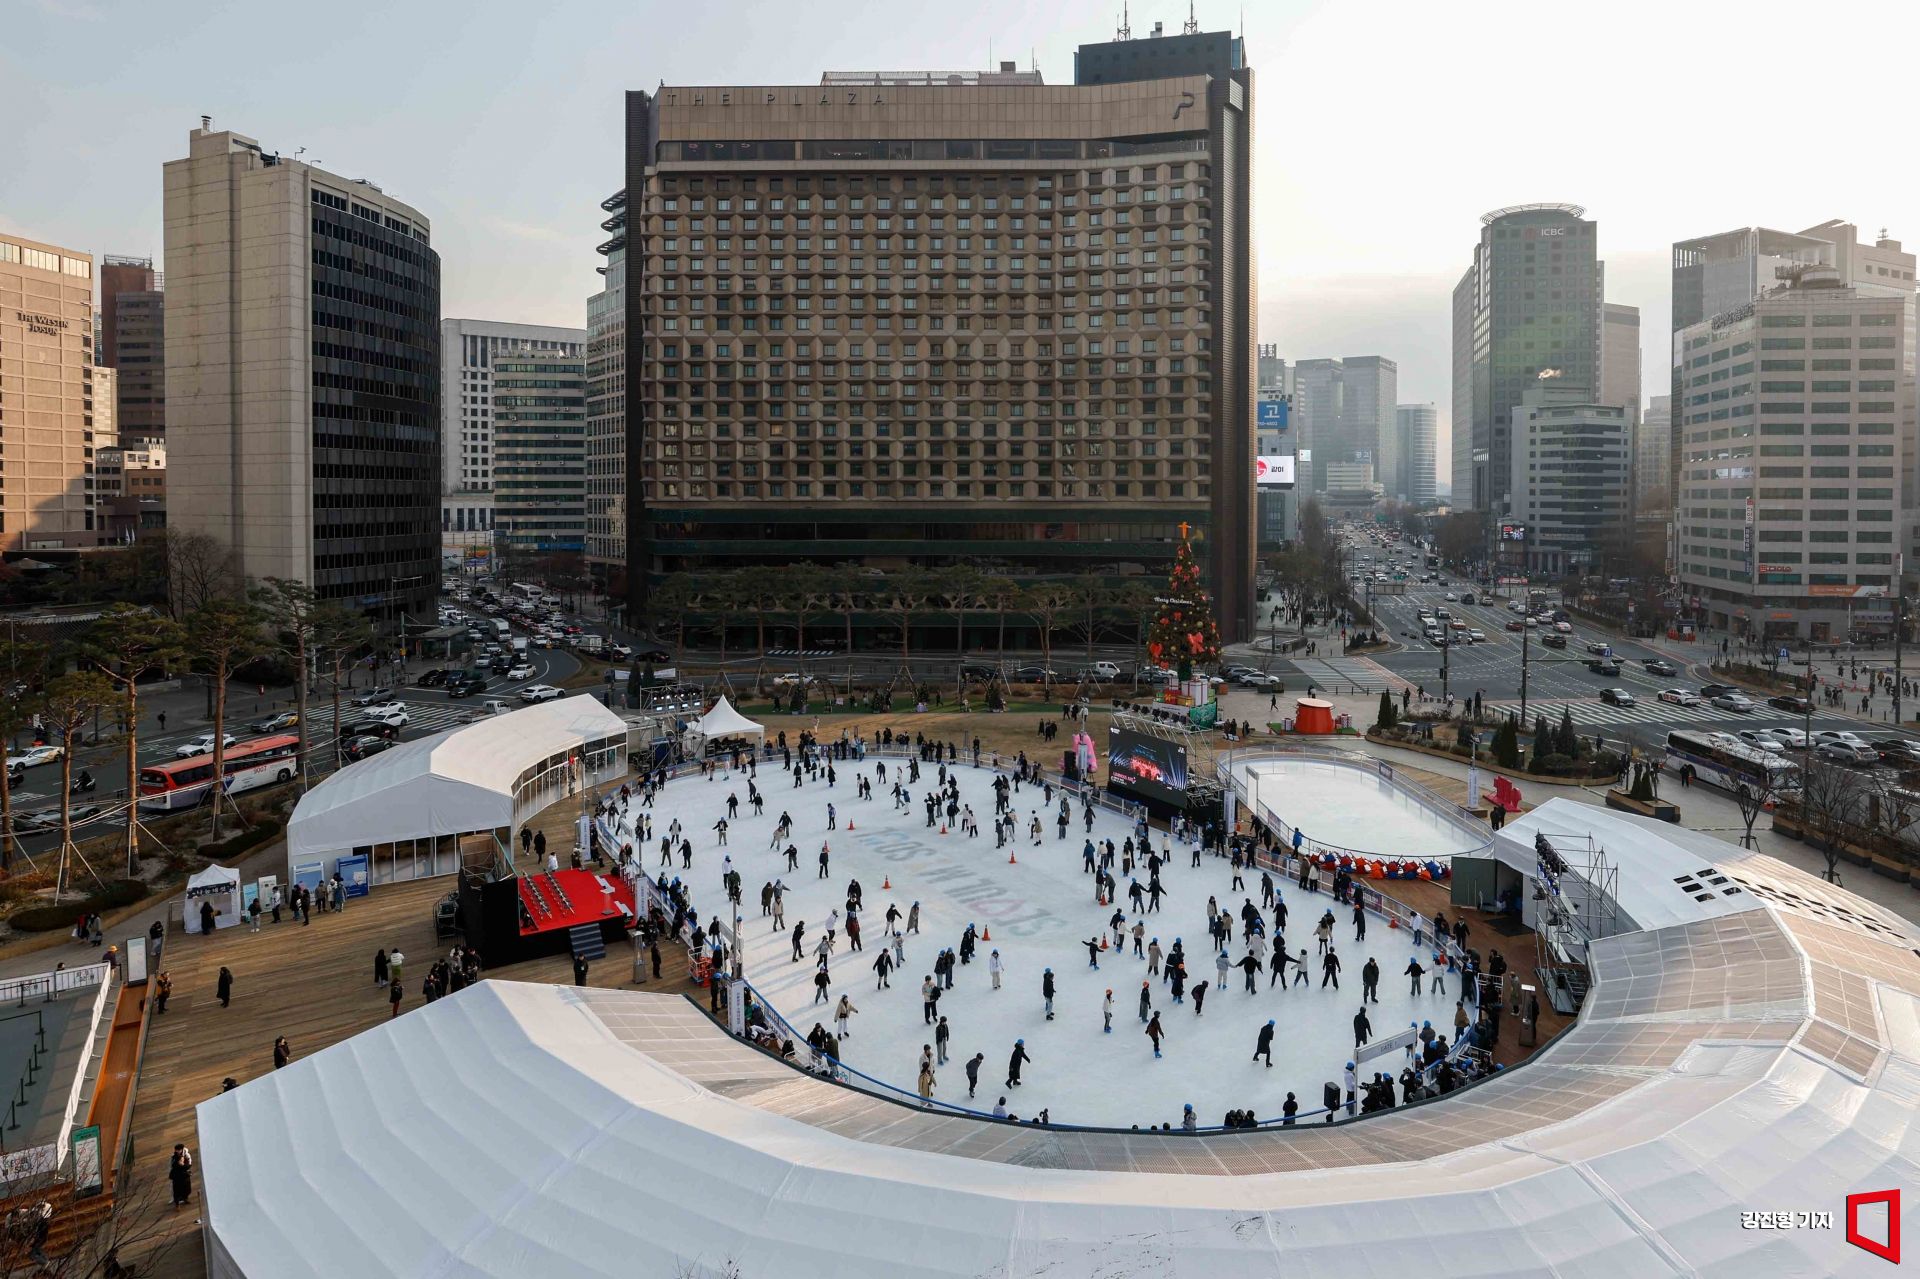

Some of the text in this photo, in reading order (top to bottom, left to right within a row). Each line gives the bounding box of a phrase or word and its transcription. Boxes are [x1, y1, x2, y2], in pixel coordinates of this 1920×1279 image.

[667, 93, 885, 106] THE PLAZA
[1541, 228, 1564, 236] ICBC
[16, 311, 69, 328] THE WESTIN
[28, 323, 58, 336] JOSUN
[1169, 597, 1193, 605] Christmas
